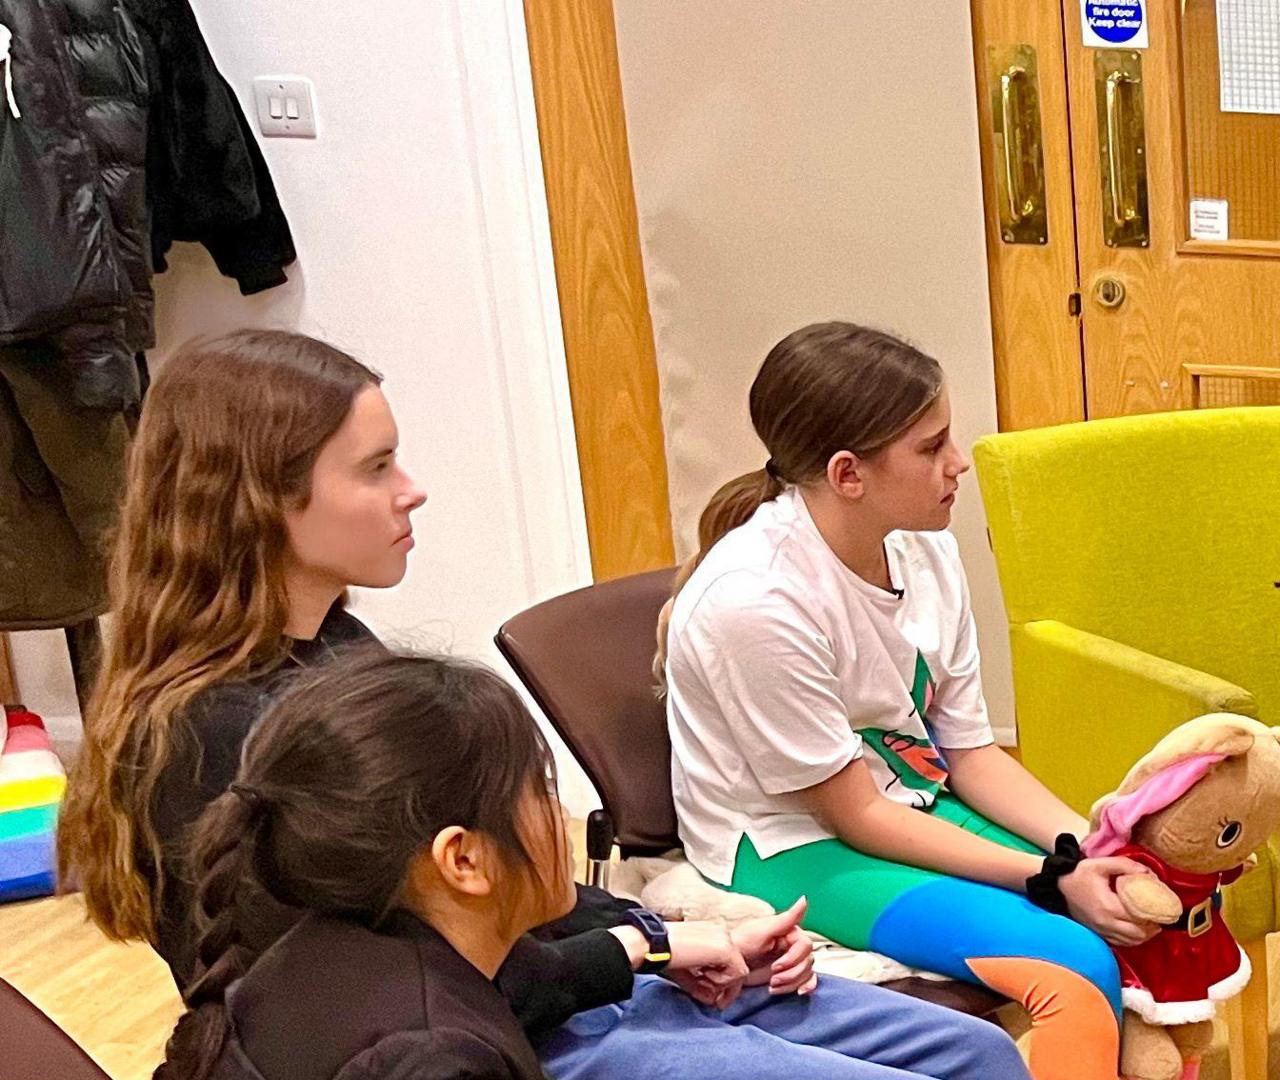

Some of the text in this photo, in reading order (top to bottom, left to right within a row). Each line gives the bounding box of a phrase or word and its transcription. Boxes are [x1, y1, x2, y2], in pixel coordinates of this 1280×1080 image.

[1093, 6, 1136, 18] fire door
[1088, 17, 1141, 29] Keep clear
